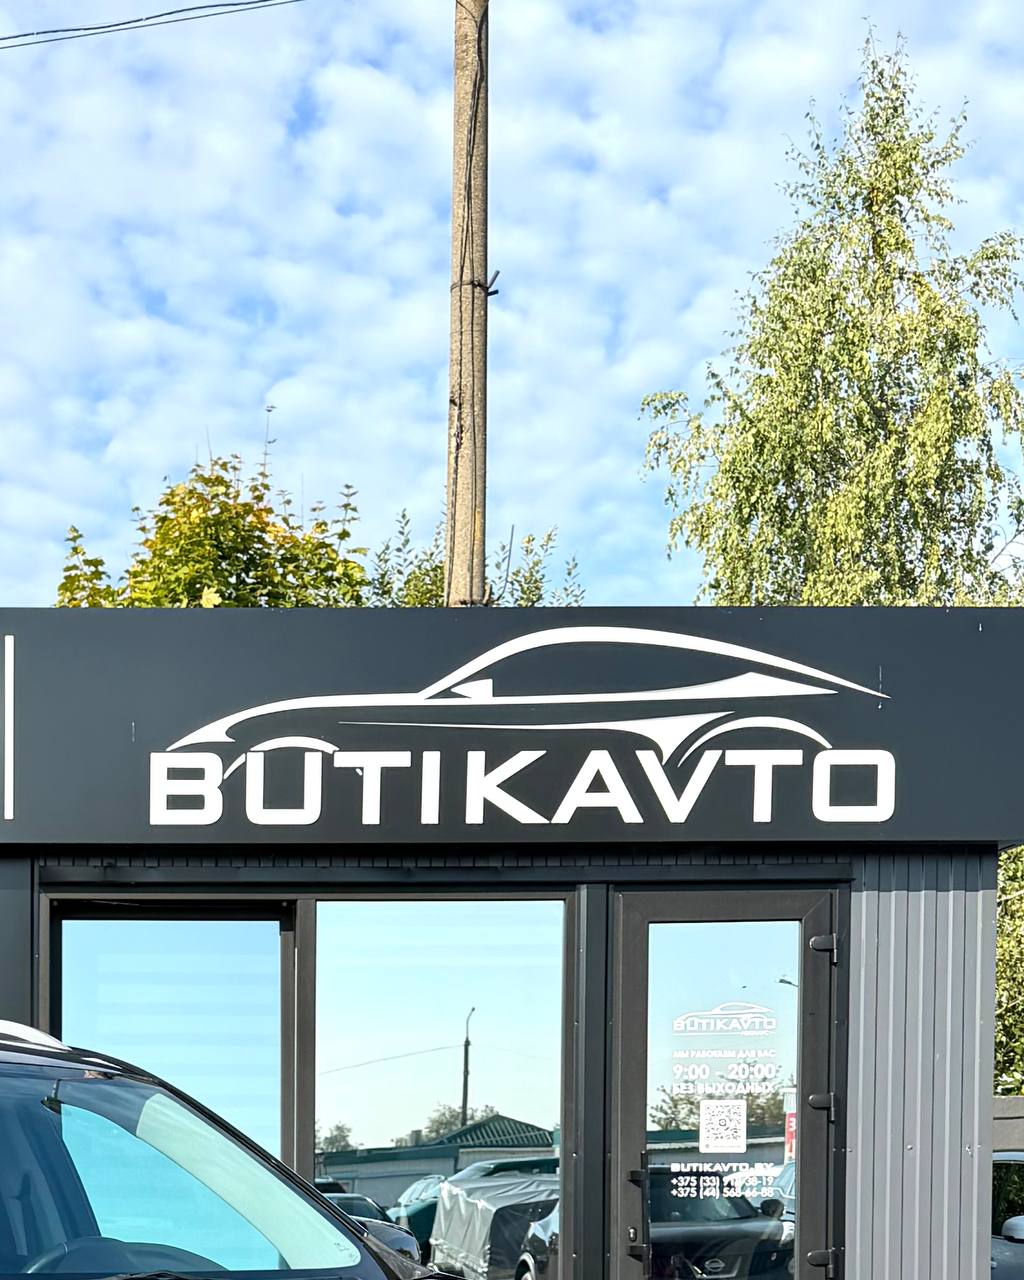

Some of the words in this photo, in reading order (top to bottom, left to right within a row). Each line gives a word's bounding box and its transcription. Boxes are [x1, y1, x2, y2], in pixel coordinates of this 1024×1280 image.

[148, 747, 896, 826] BUTIKAVTO
[672, 1017, 777, 1031] BUTIKAVTO
[672, 1063, 710, 1080] 9:00
[728, 1063, 777, 1080] 20:00
[672, 1082, 696, 1095] БЕЗ
[696, 1082, 776, 1096] ВЫХОДНЫХ
[671, 1162, 774, 1172] BUTIKAVTO.BY
[671, 1176, 697, 1187] +375
[699, 1175, 720, 1188] (33)
[671, 1187, 697, 1197] +375
[699, 1187, 720, 1199] (44)
